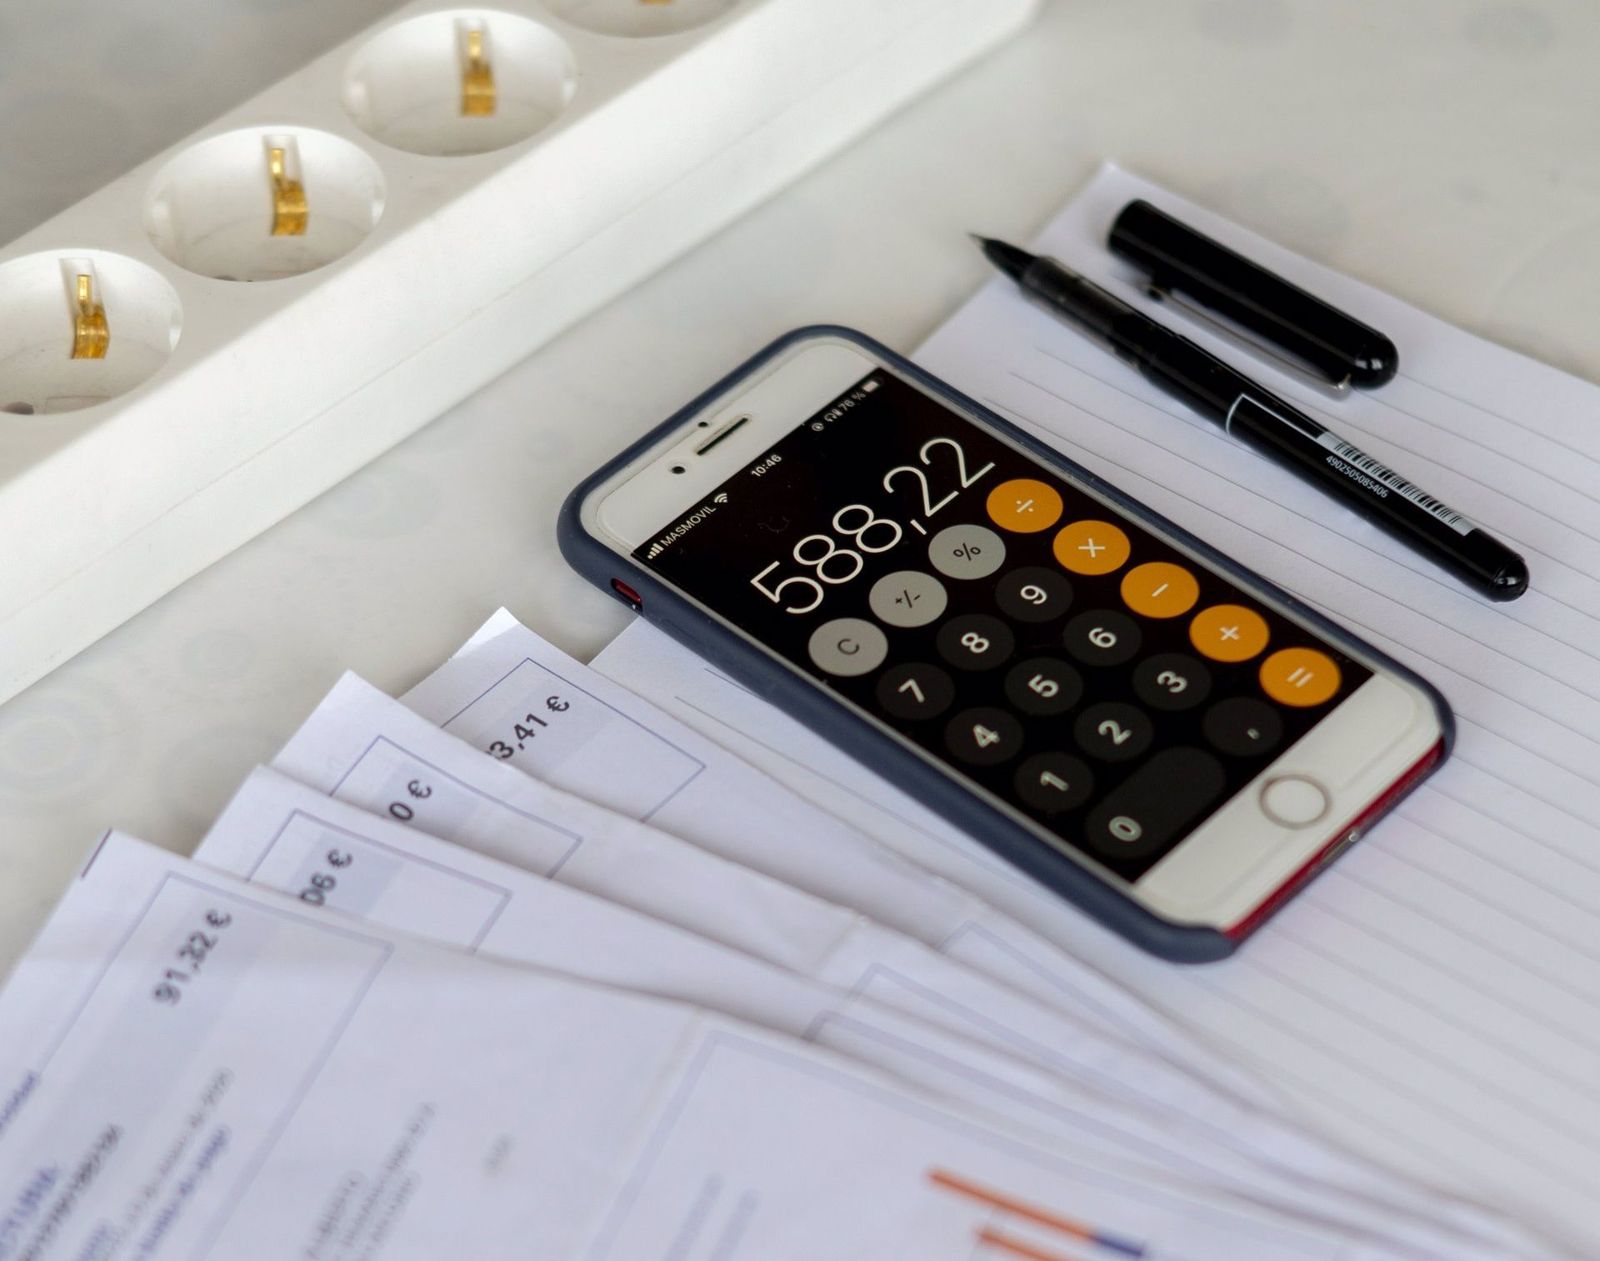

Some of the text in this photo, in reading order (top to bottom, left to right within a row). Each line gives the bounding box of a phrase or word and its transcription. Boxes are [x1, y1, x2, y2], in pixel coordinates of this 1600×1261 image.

[751, 454, 782, 477] 10:46
[1325, 455, 1389, 499] 4902505085406
[660, 506, 717, 547] MASMOVIL
[750, 437, 996, 615] 588,22
[836, 638, 860, 656] C
[952, 541, 982, 562] %
[898, 678, 926, 703] 7
[960, 631, 991, 655] 8
[1020, 583, 1048, 606] 9
[972, 723, 1001, 749] 4
[1028, 673, 1060, 698] 5
[1087, 626, 1118, 649] 6
[486, 695, 570, 760] 3,41 €
[1040, 769, 1069, 792] 1
[1097, 719, 1132, 746] 2
[1156, 670, 1189, 694] 3
[408, 779, 432, 799] €
[1107, 815, 1143, 843] 0
